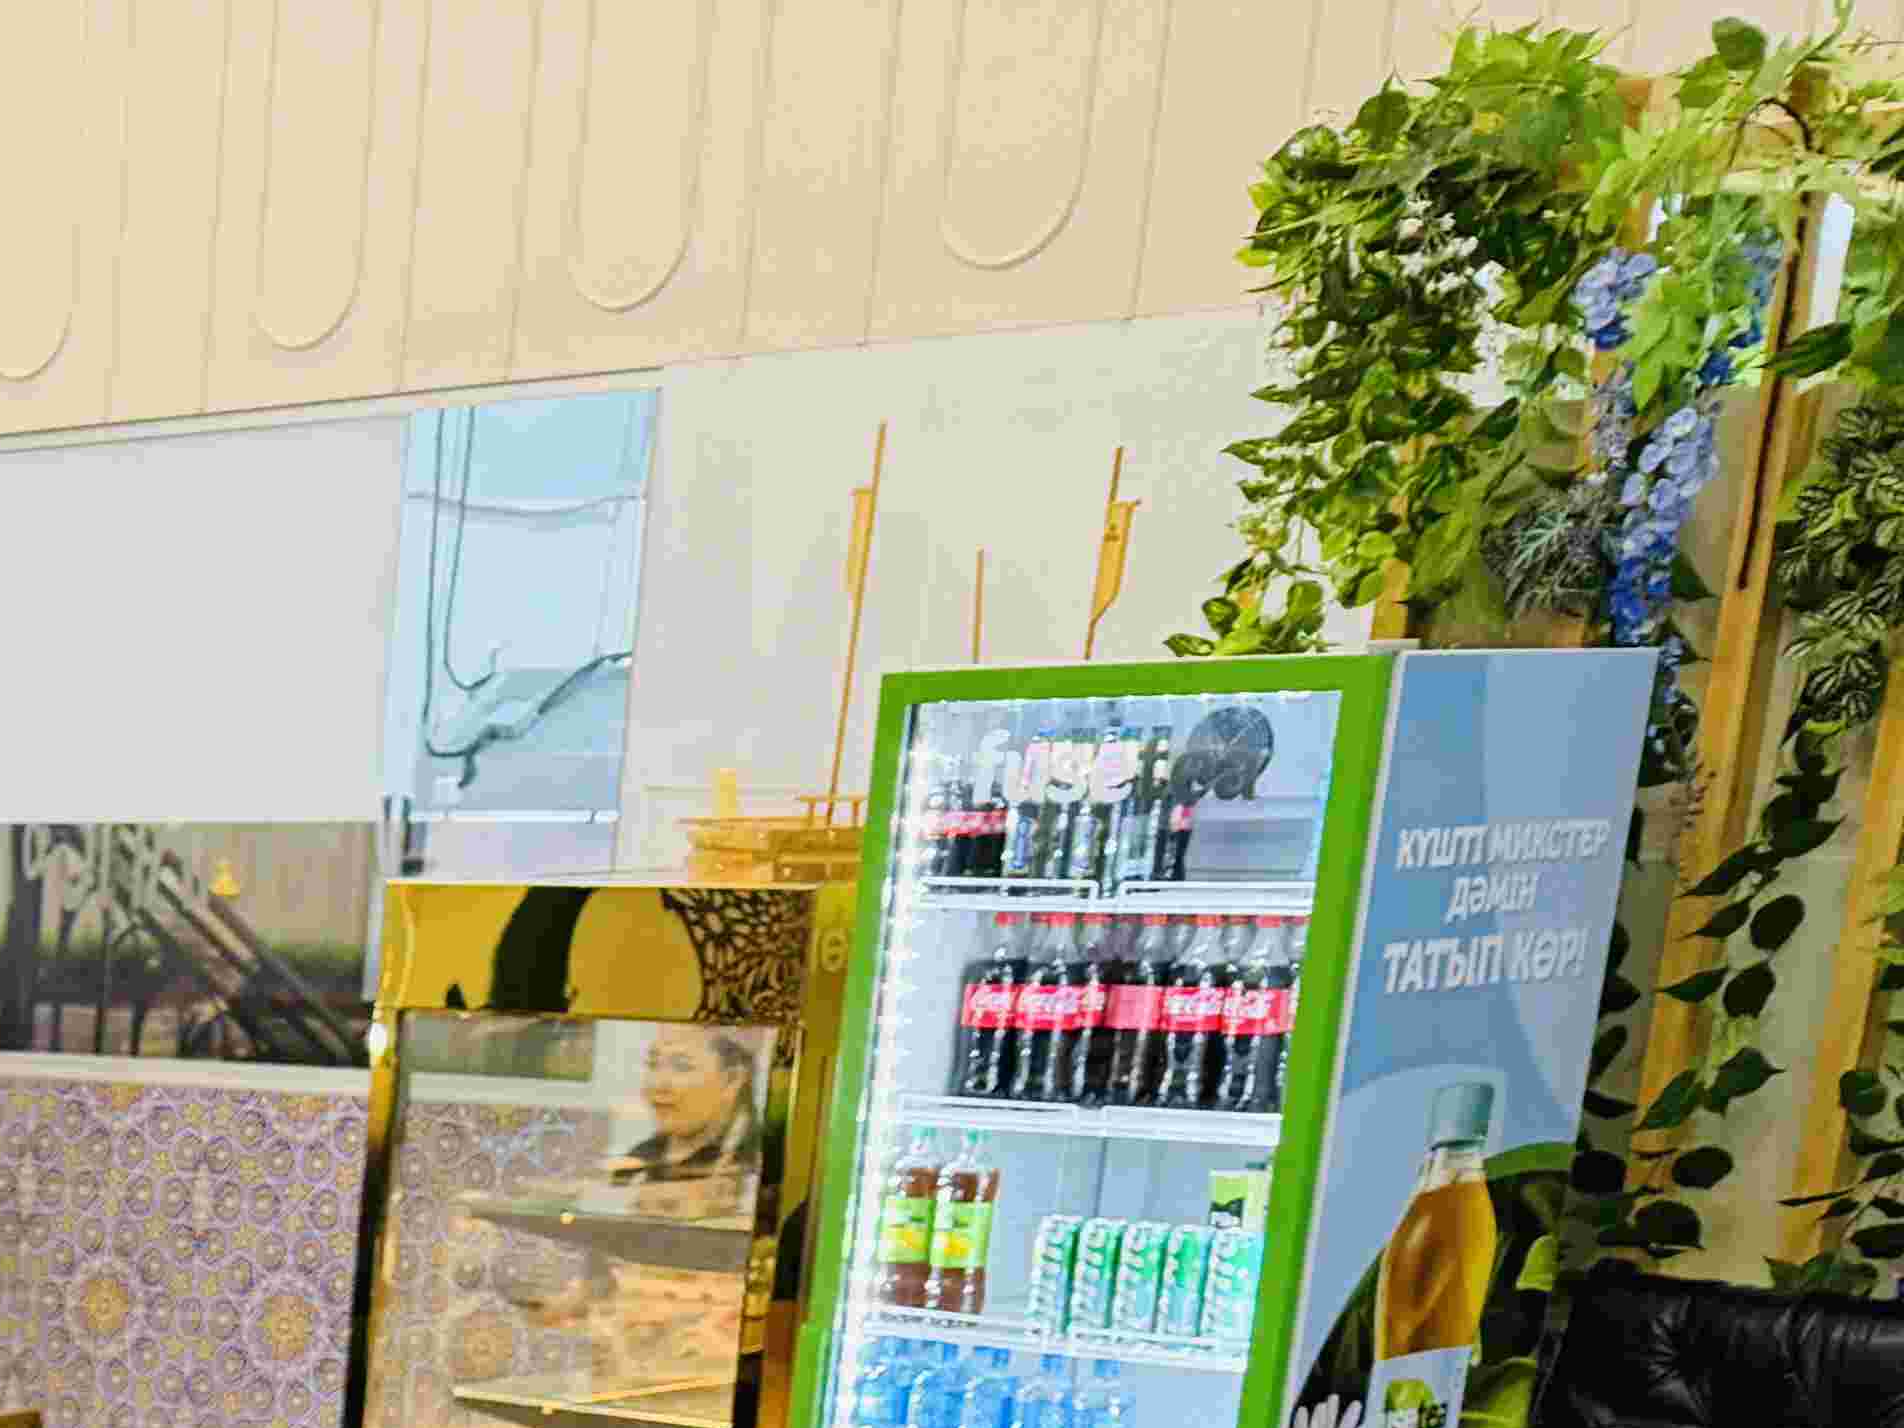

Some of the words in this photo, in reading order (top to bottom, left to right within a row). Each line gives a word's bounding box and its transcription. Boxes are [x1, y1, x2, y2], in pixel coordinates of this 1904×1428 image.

[1488, 817, 1611, 865] МИКСТЕР
[1444, 871, 1540, 925] ДӘМІН
[1383, 935, 1505, 994] ТАТЫП
[1508, 927, 1589, 984] КӨР!
